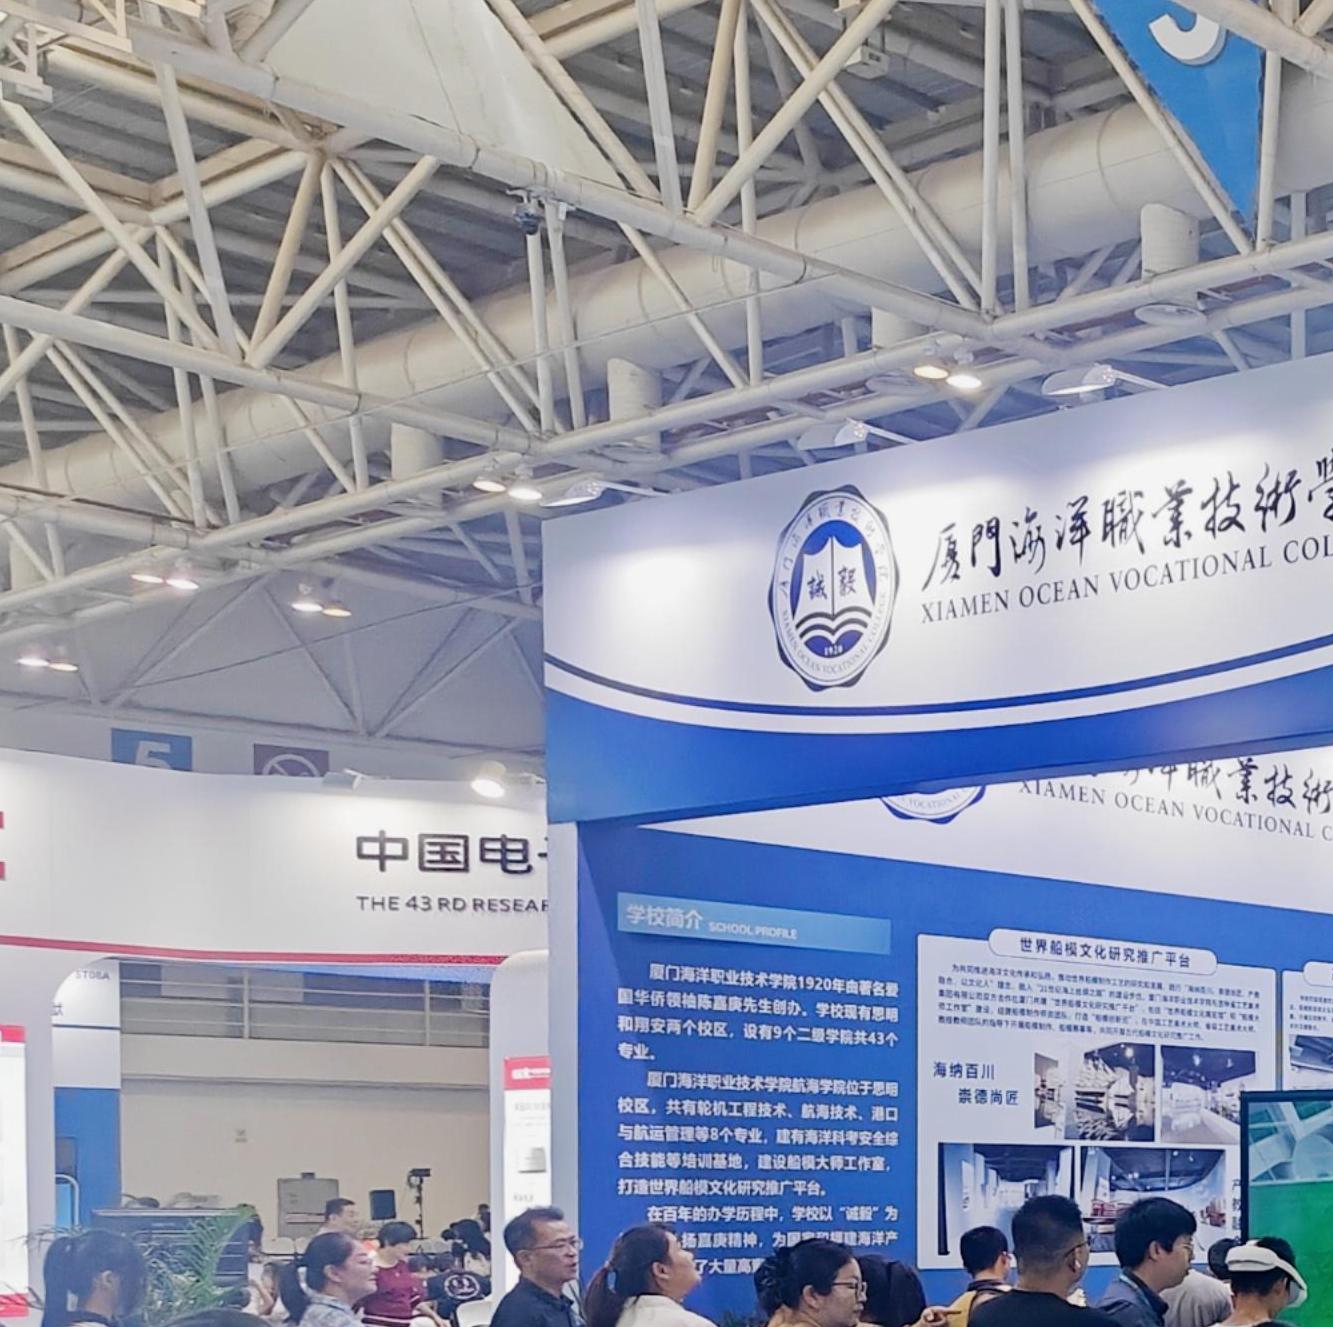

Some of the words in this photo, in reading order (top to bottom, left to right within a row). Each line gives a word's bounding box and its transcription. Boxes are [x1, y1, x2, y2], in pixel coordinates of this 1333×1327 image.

[920, 590, 1010, 624] XIAMEN
[1018, 574, 1100, 610] OCEAN
[1108, 543, 1273, 593] VOCATIONAL
[1018, 779, 1106, 805] XIAMEN
[1114, 791, 1185, 819] OCEAN
[1193, 804, 1316, 840] VOCATIONAL
[356, 830, 548, 875] 中国电
[356, 896, 400, 912] THE
[405, 895, 432, 912] 43
[437, 897, 466, 912] RD
[626, 904, 703, 930] 学校简介
[709, 920, 752, 936] SCHOOL
[755, 926, 798, 941] PROFILE
[1019, 936, 1191, 968] 世界船模文化研究推广平台
[618, 1043, 655, 1060] 专业。
[933, 1062, 995, 1081] 海纳百川
[958, 1087, 1019, 1106] 崇德尚匠
